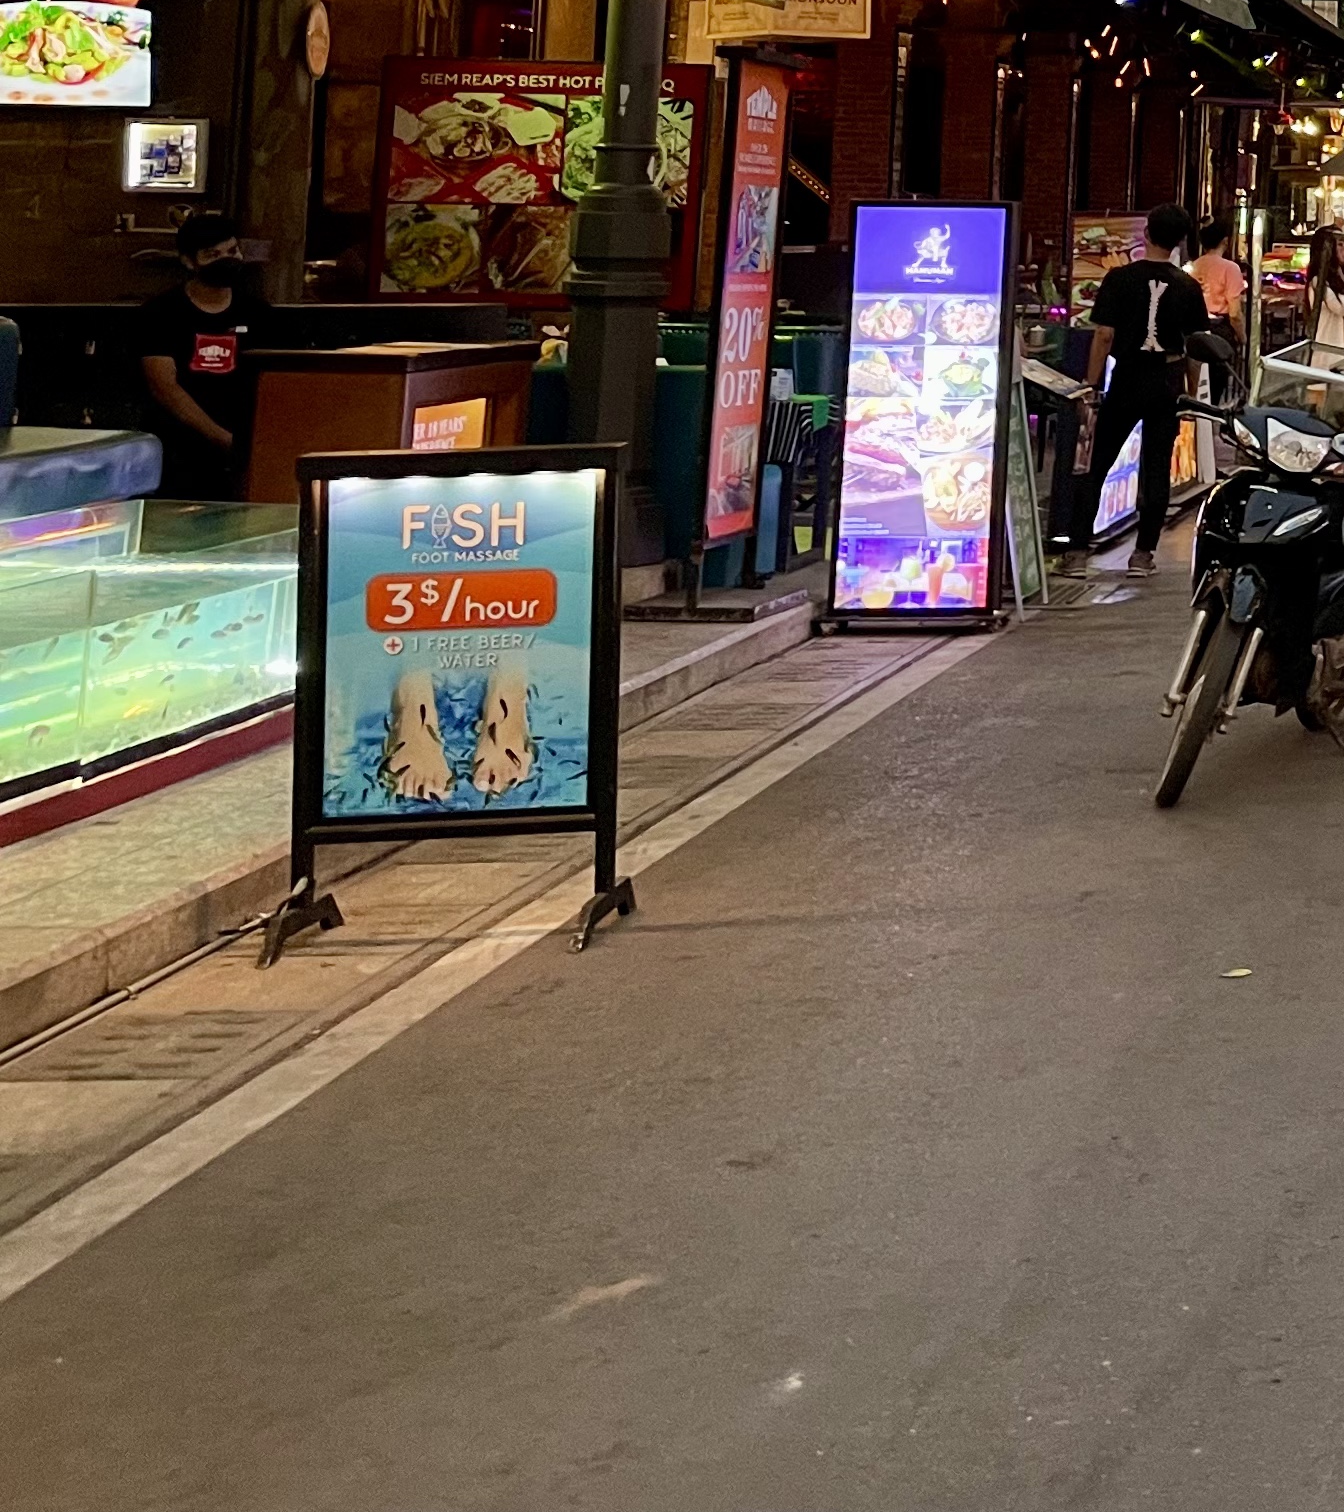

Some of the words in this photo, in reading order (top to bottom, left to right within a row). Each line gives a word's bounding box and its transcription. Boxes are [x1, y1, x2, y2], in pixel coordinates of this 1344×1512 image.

[420, 73, 458, 86] SIEM
[461, 72, 515, 87] REAP'S
[518, 75, 556, 88] BEST
[558, 76, 593, 89] HOT
[721, 306, 764, 364] 20%
[720, 369, 762, 408] OFF
[411, 550, 450, 565] FOOT
[454, 549, 520, 563] MASSAGE
[426, 635, 471, 652] FREE
[439, 652, 499, 669] WATER
